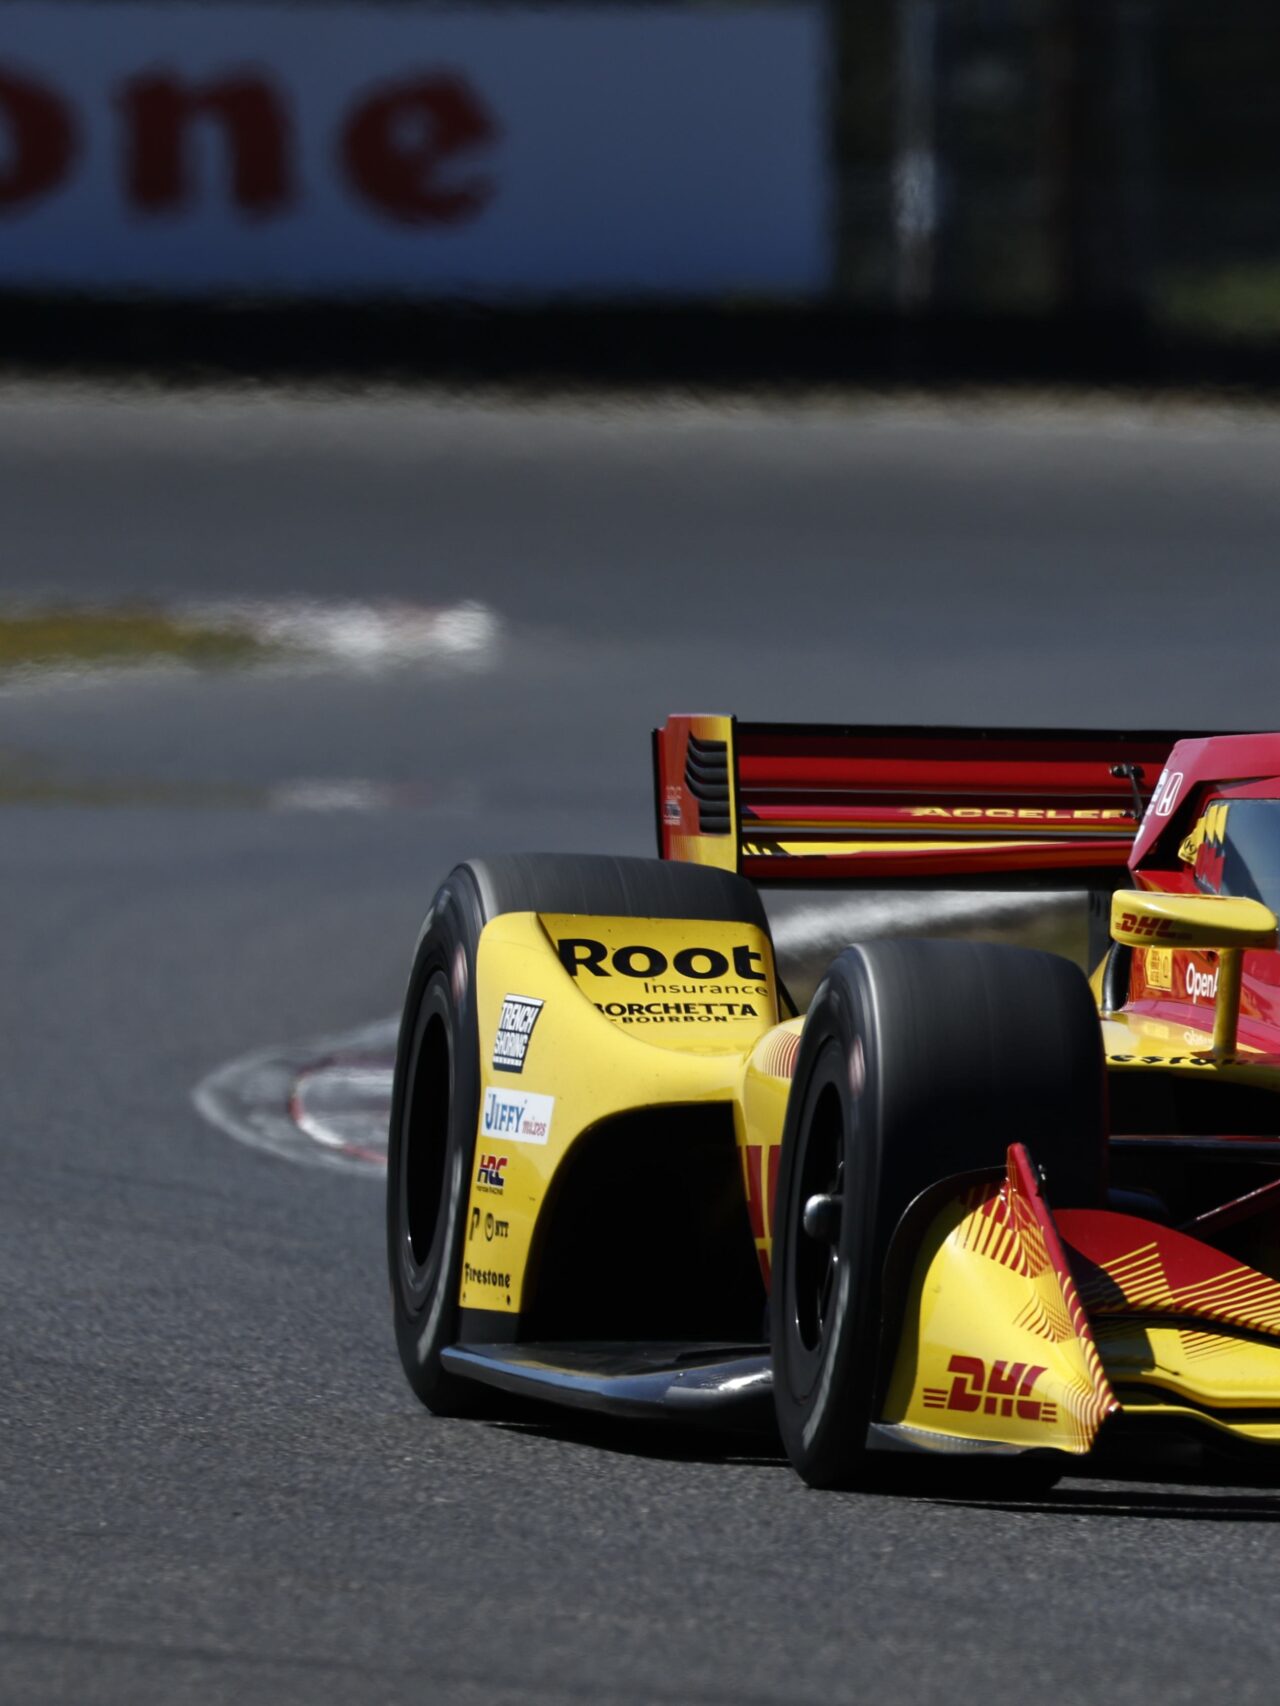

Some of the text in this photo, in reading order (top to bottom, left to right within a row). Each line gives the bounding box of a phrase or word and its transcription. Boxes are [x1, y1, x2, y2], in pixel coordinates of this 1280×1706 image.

[1117, 913, 1179, 939] DHL
[557, 938, 767, 982] Root
[643, 981, 769, 997] Insurance
[498, 1001, 540, 1035] TRENCH
[622, 1015, 728, 1024] BOURBON
[485, 1093, 526, 1135] JIFFY
[477, 1154, 508, 1188] HRC
[464, 1261, 511, 1289] Firestone
[947, 1354, 1049, 1421] DHL
